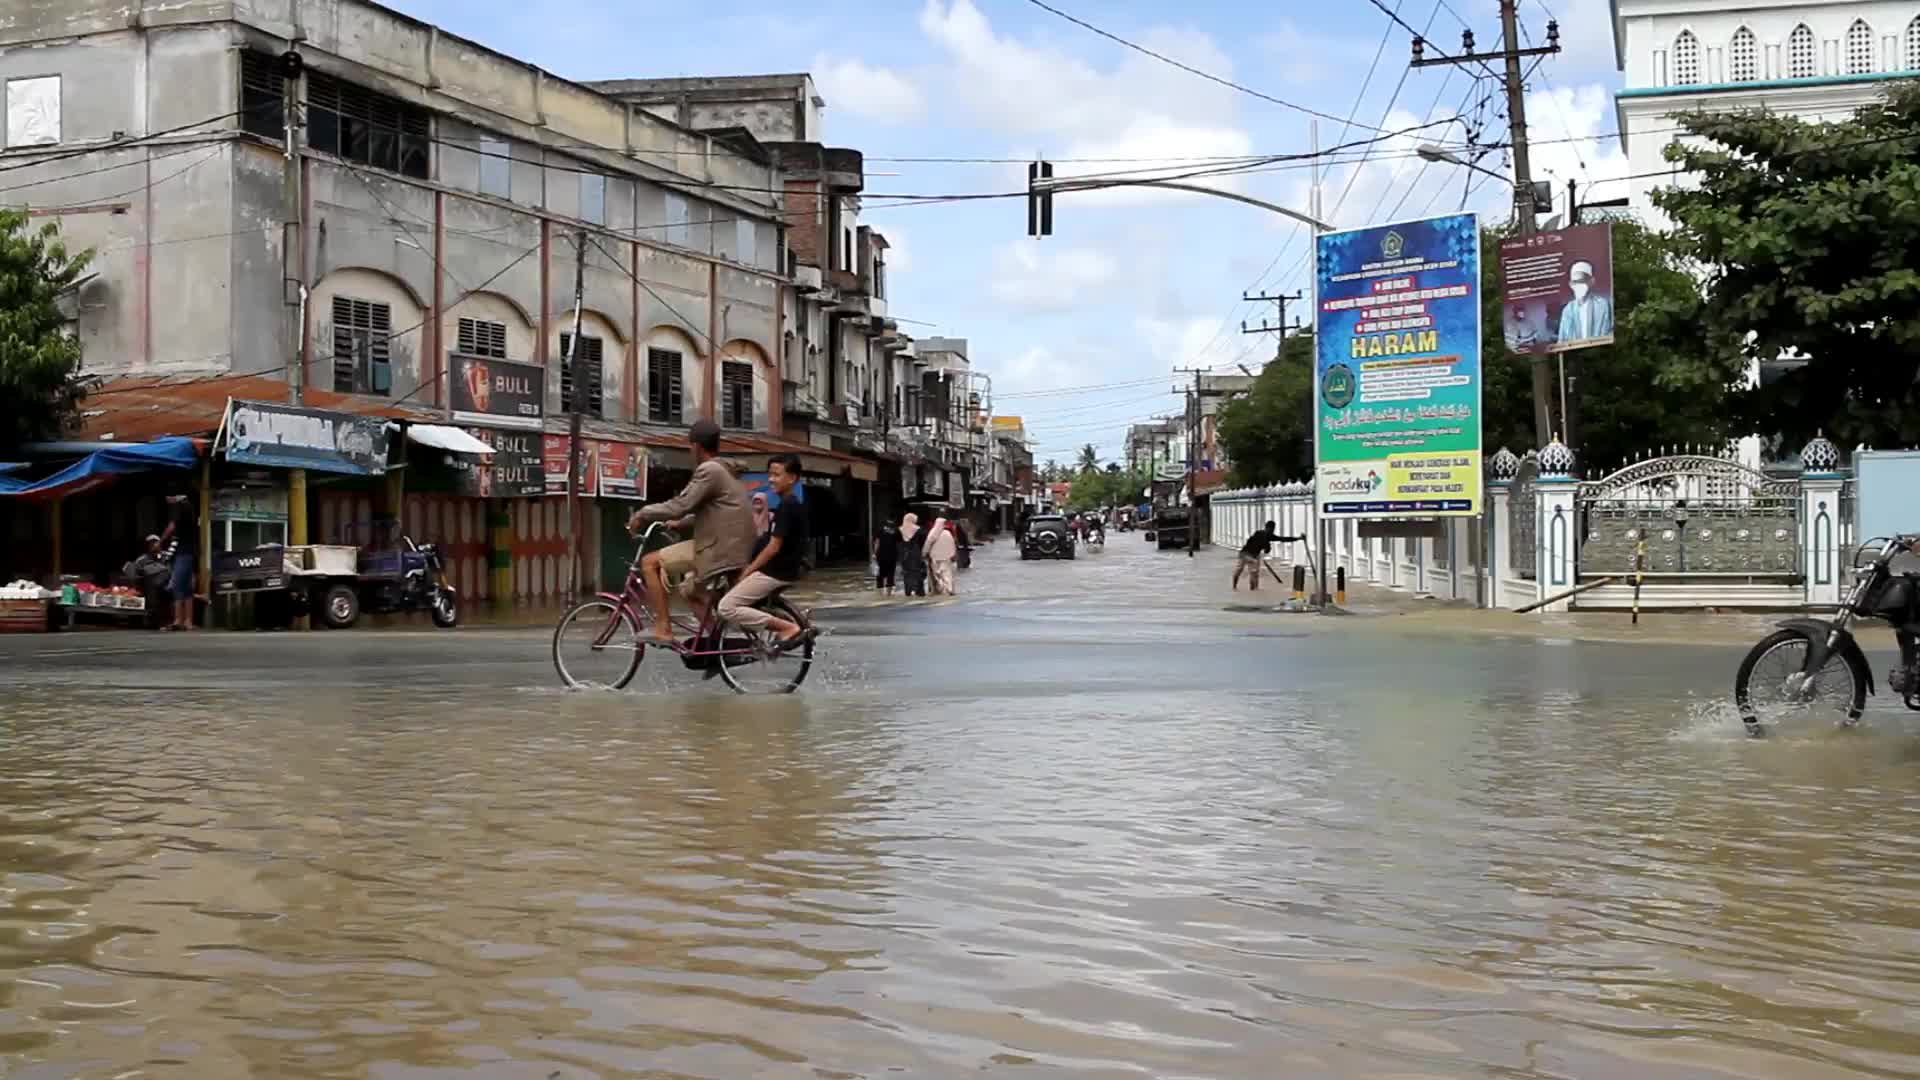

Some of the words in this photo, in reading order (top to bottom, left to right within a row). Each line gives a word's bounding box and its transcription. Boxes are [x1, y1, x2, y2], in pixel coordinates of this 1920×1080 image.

[1351, 330, 1437, 358] HARAM
[496, 375, 532, 395] BULL
[496, 435, 530, 453] BULL
[496, 466, 529, 483] BULL
[238, 557, 261, 567] VIAR
